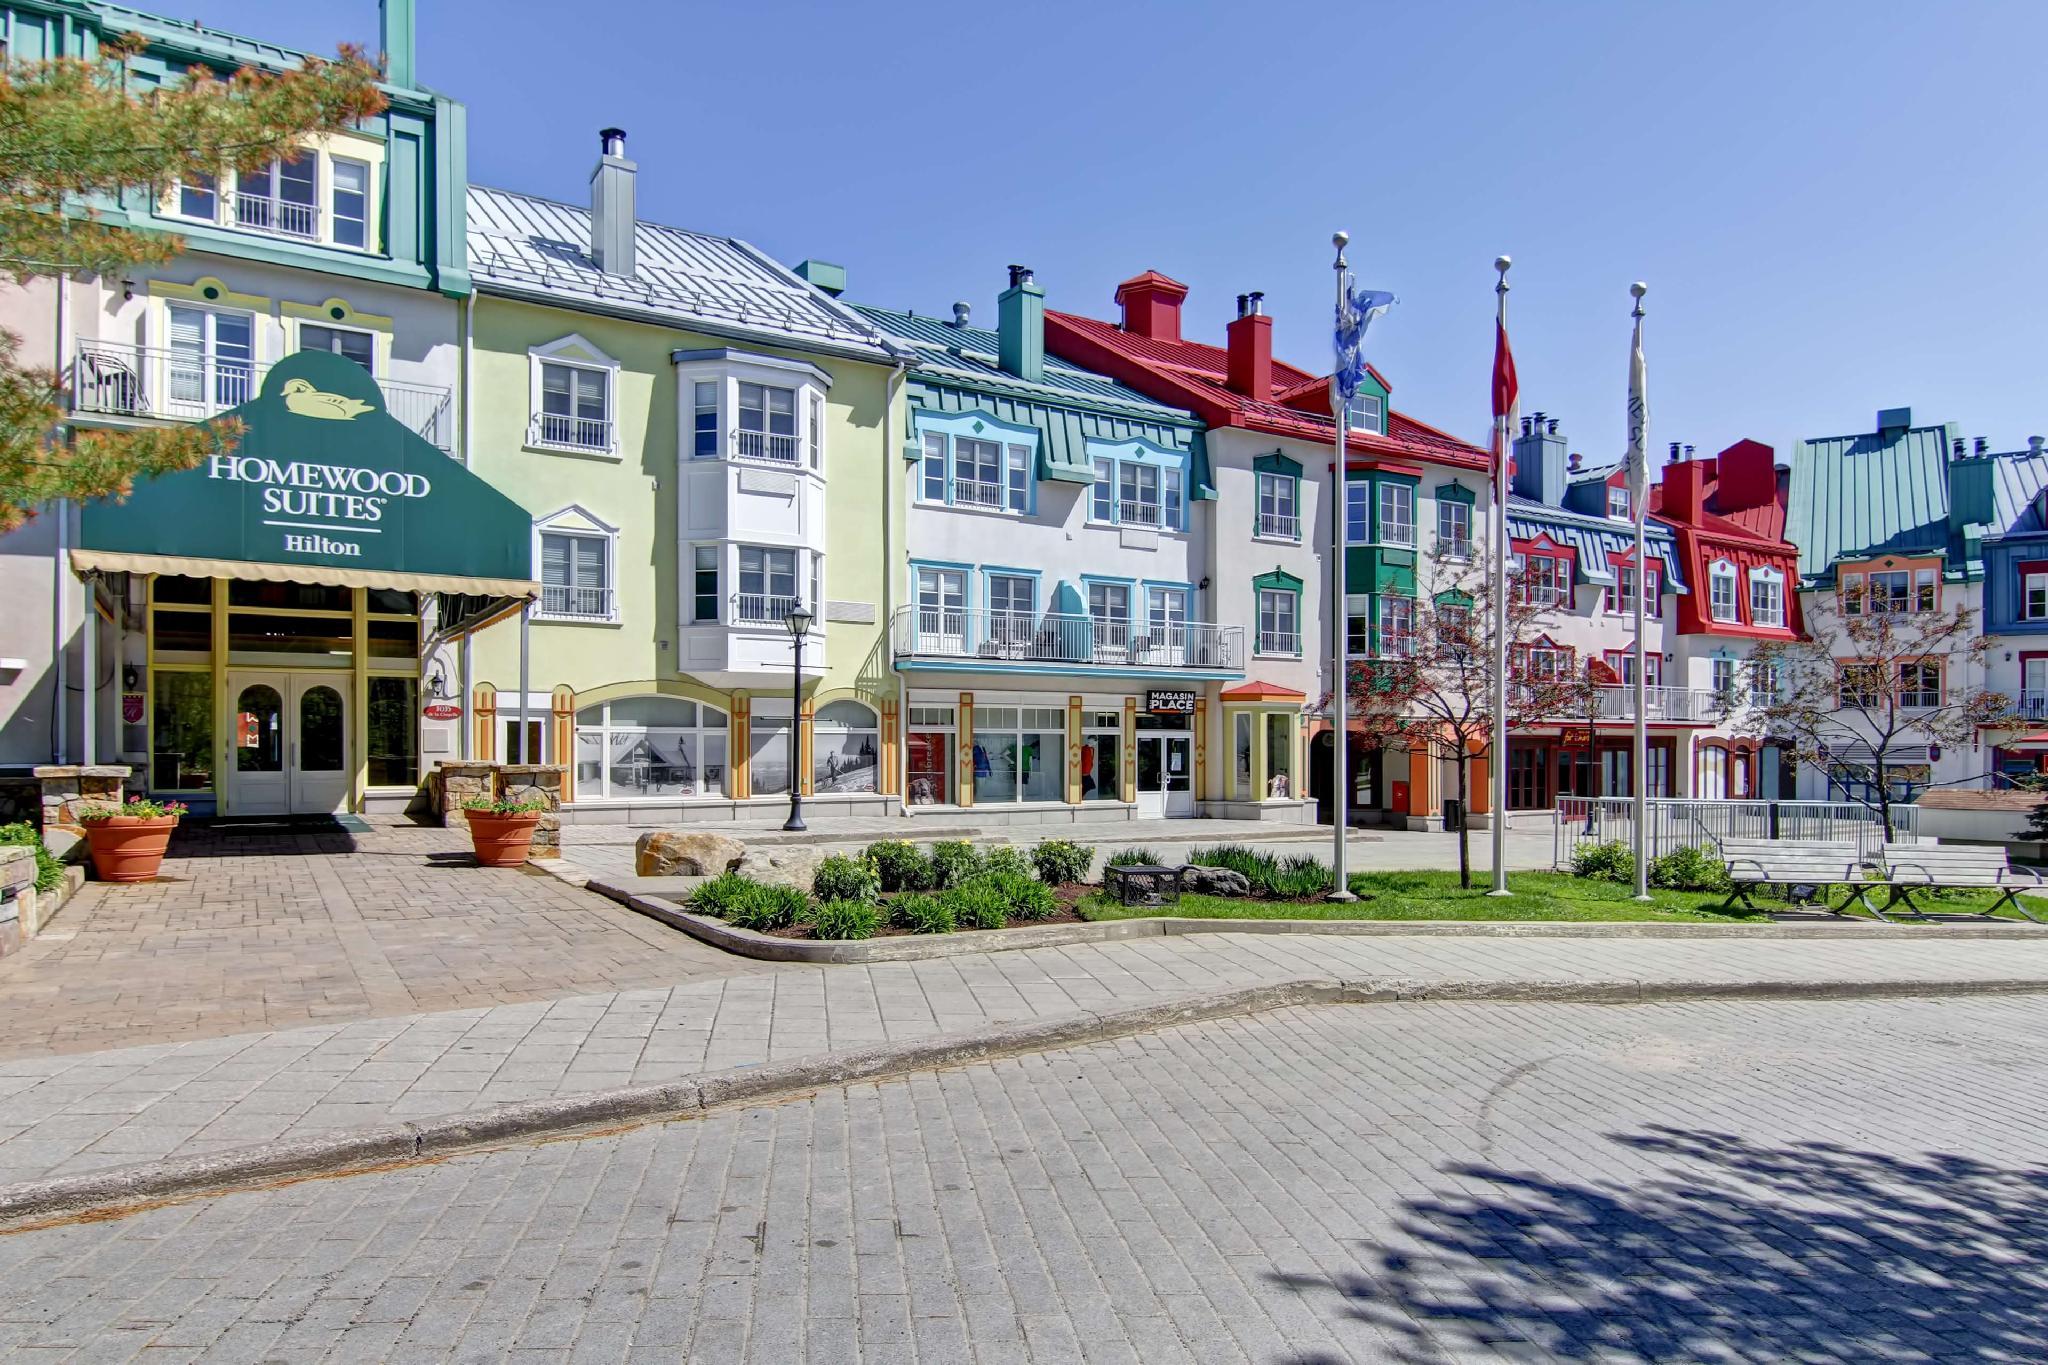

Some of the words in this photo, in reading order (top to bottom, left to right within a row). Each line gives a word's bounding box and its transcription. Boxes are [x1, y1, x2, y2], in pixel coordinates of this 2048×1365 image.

[207, 454, 431, 498] HOMEWOOD
[263, 487, 384, 521] SUITES
[285, 534, 362, 556] Hilton
[1151, 692, 1194, 700] MAGASIN
[1151, 700, 1194, 710] PLACE
